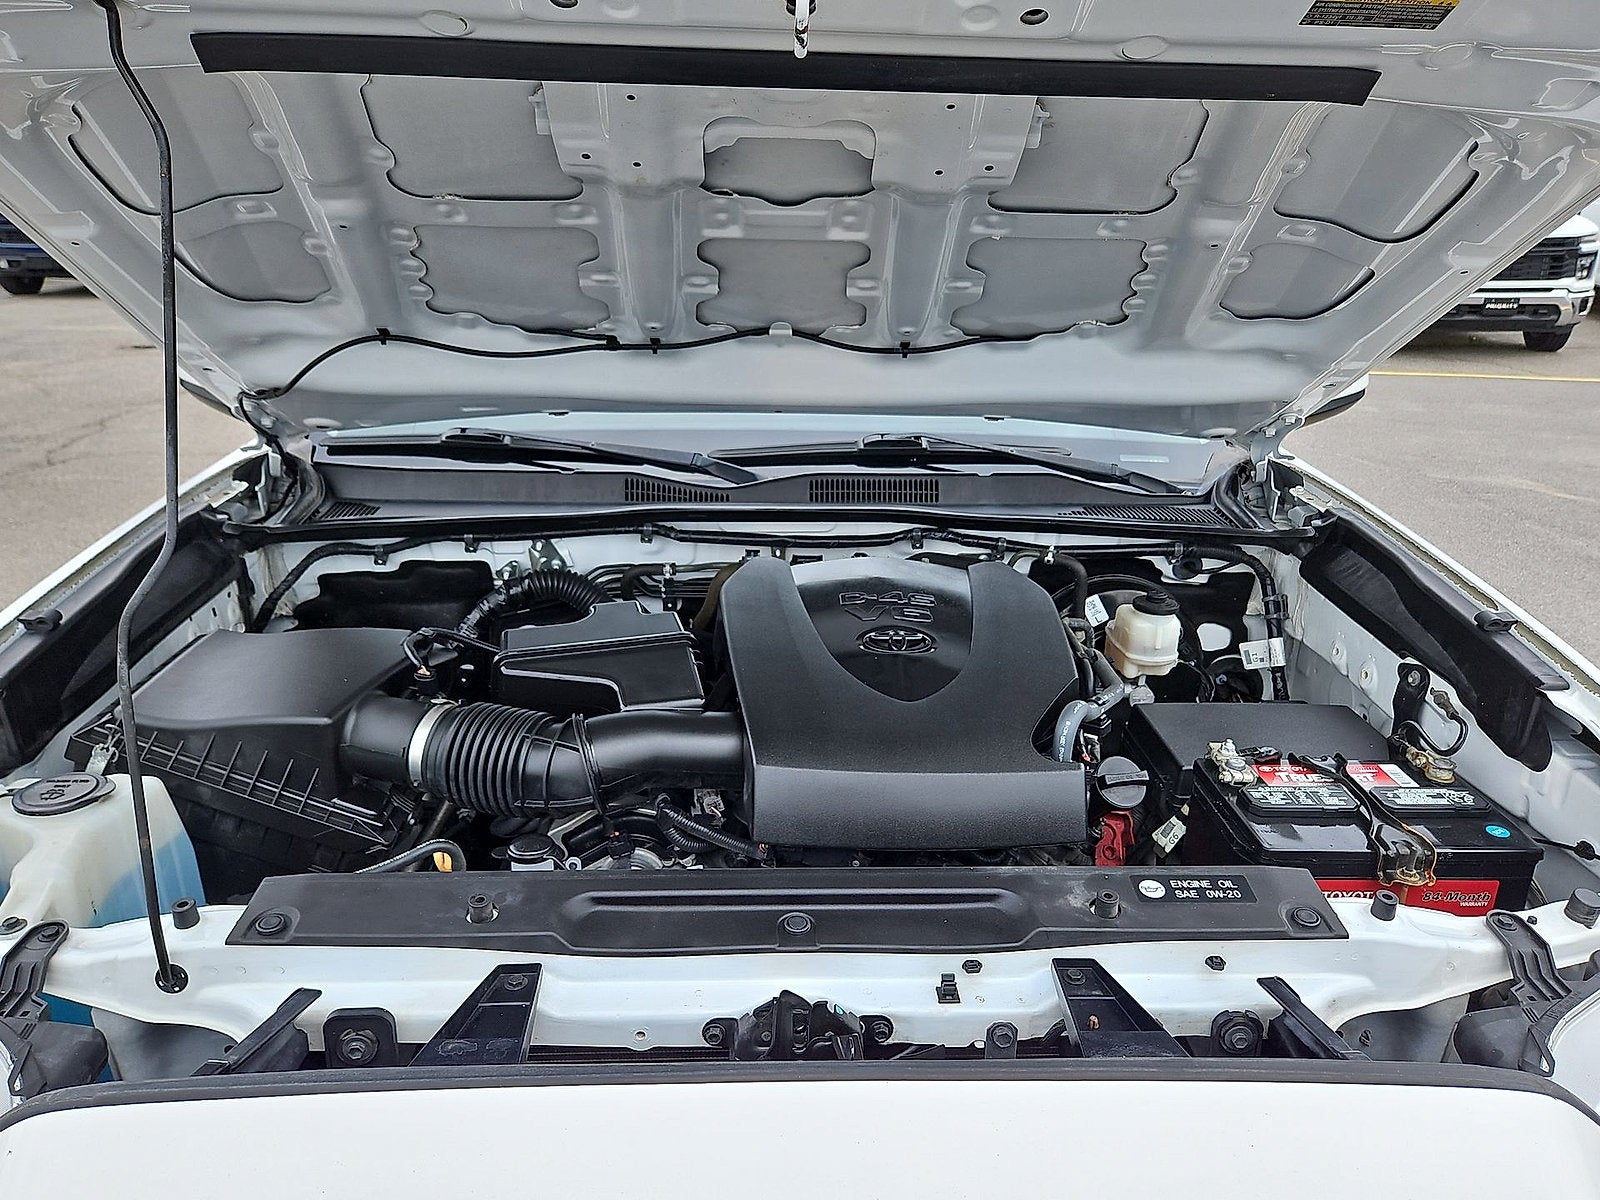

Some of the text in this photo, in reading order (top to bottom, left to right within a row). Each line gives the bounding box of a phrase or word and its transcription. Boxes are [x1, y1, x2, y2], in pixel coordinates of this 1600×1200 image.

[1168, 832, 1179, 845] G6
[1169, 879, 1238, 889] ENGINE OIL
[1175, 889, 1242, 899] SAE 0W-20
[1322, 891, 1376, 899] TOYOT
[1422, 891, 1491, 902] 84-Month
